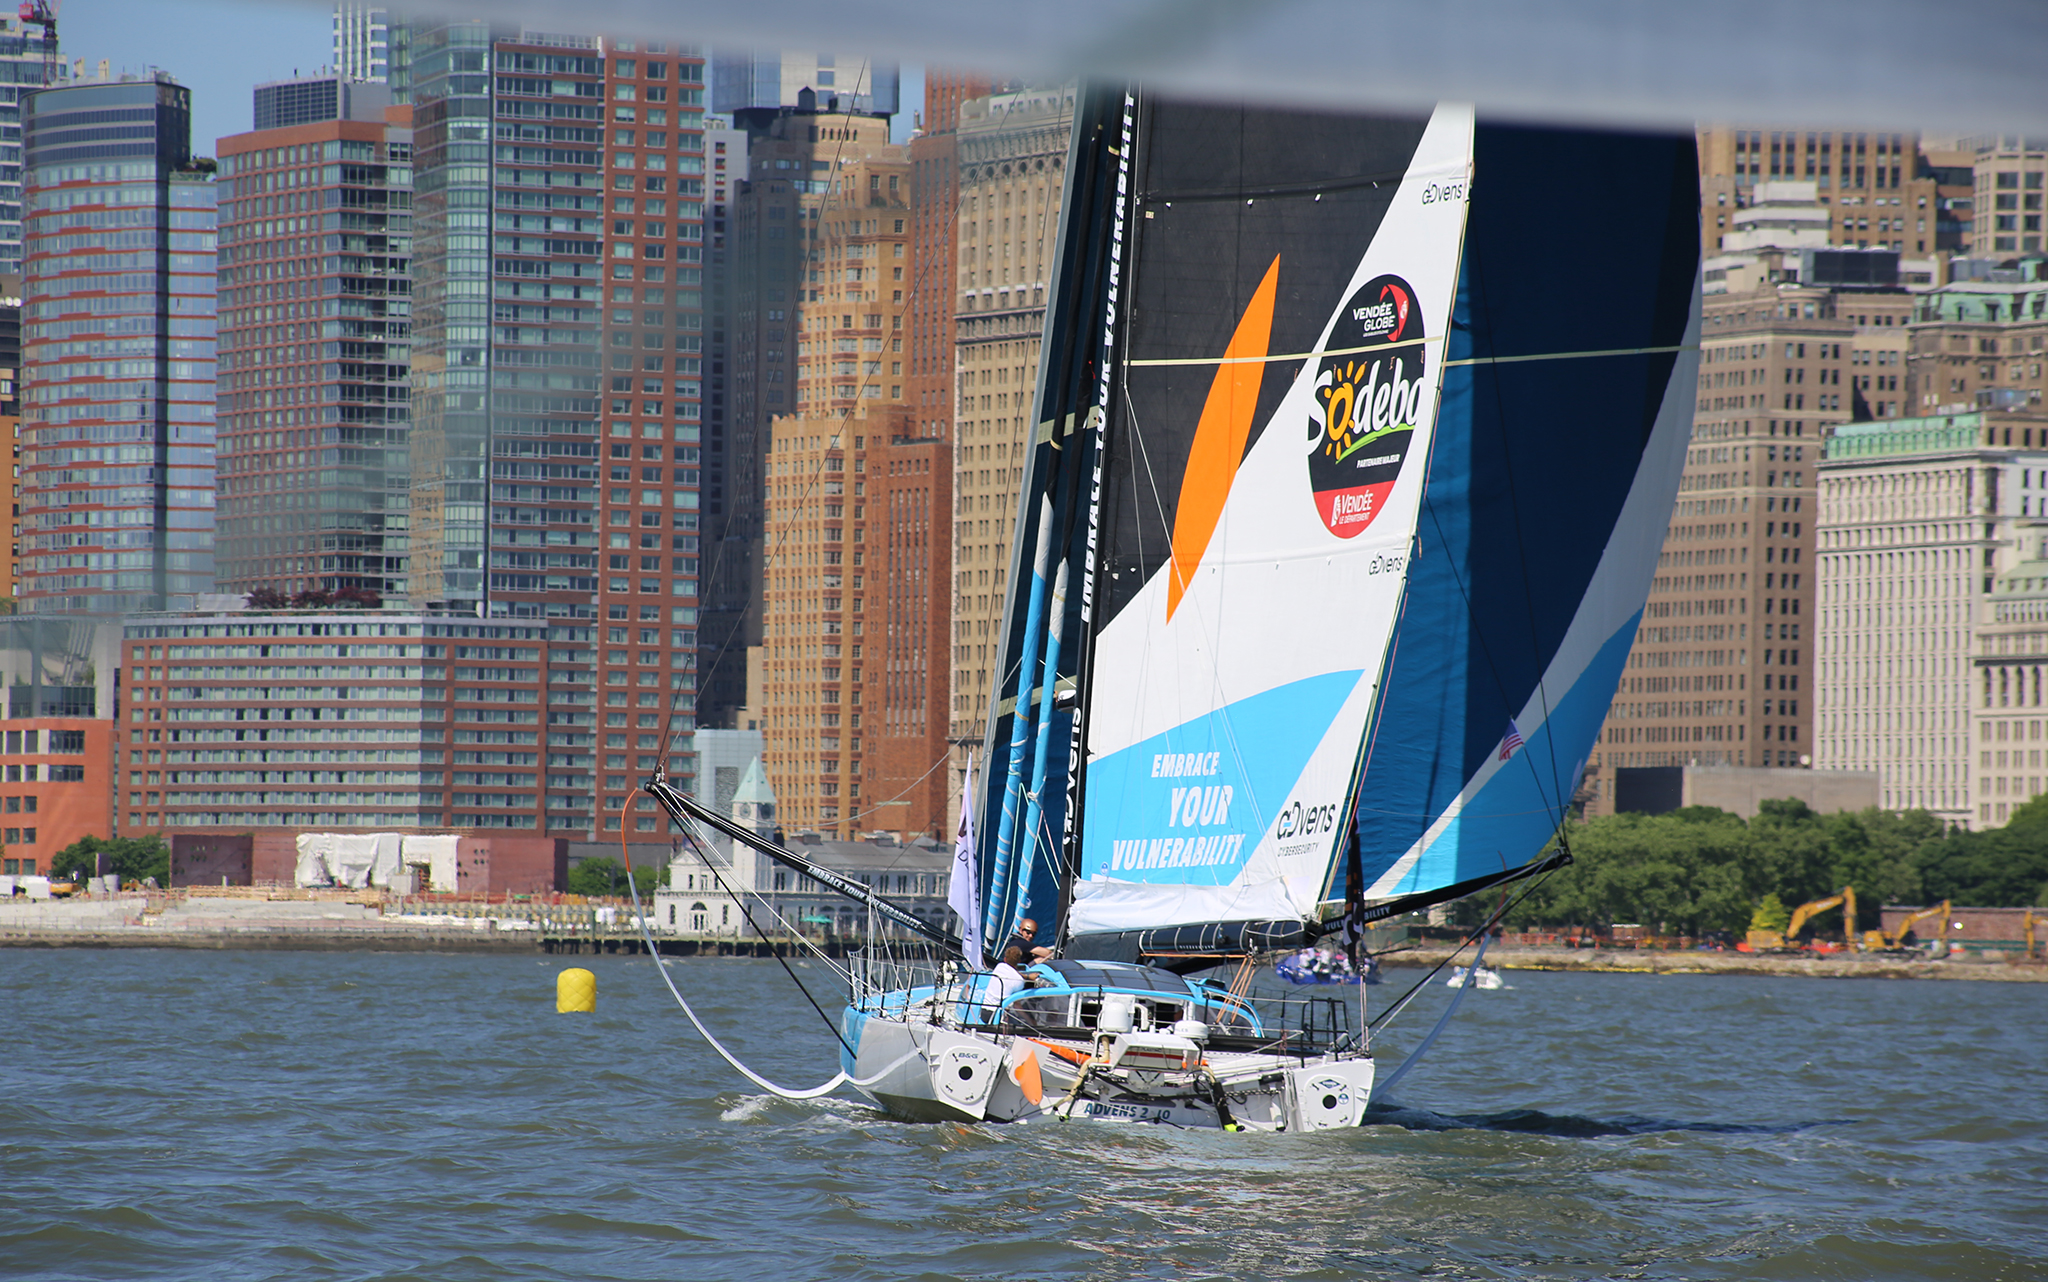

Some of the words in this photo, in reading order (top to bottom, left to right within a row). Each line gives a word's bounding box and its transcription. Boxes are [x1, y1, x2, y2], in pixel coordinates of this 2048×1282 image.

[1353, 302, 1393, 320] VENDÉE
[1363, 315, 1396, 332] GLOBE
[1081, 466, 1101, 623] EMBRACE
[1095, 360, 1112, 450] YOUR
[1104, 91, 1134, 347] VULNERABILITY
[1342, 489, 1374, 514] VENDÉE
[1151, 752, 1220, 778] EMBRACE
[1169, 785, 1233, 828] YOUR
[1111, 834, 1246, 871] VULNERABILITY
[807, 865, 843, 890] EMBRACE
[843, 884, 866, 899] YOUR
[1084, 1103, 1137, 1118] ADVENS
